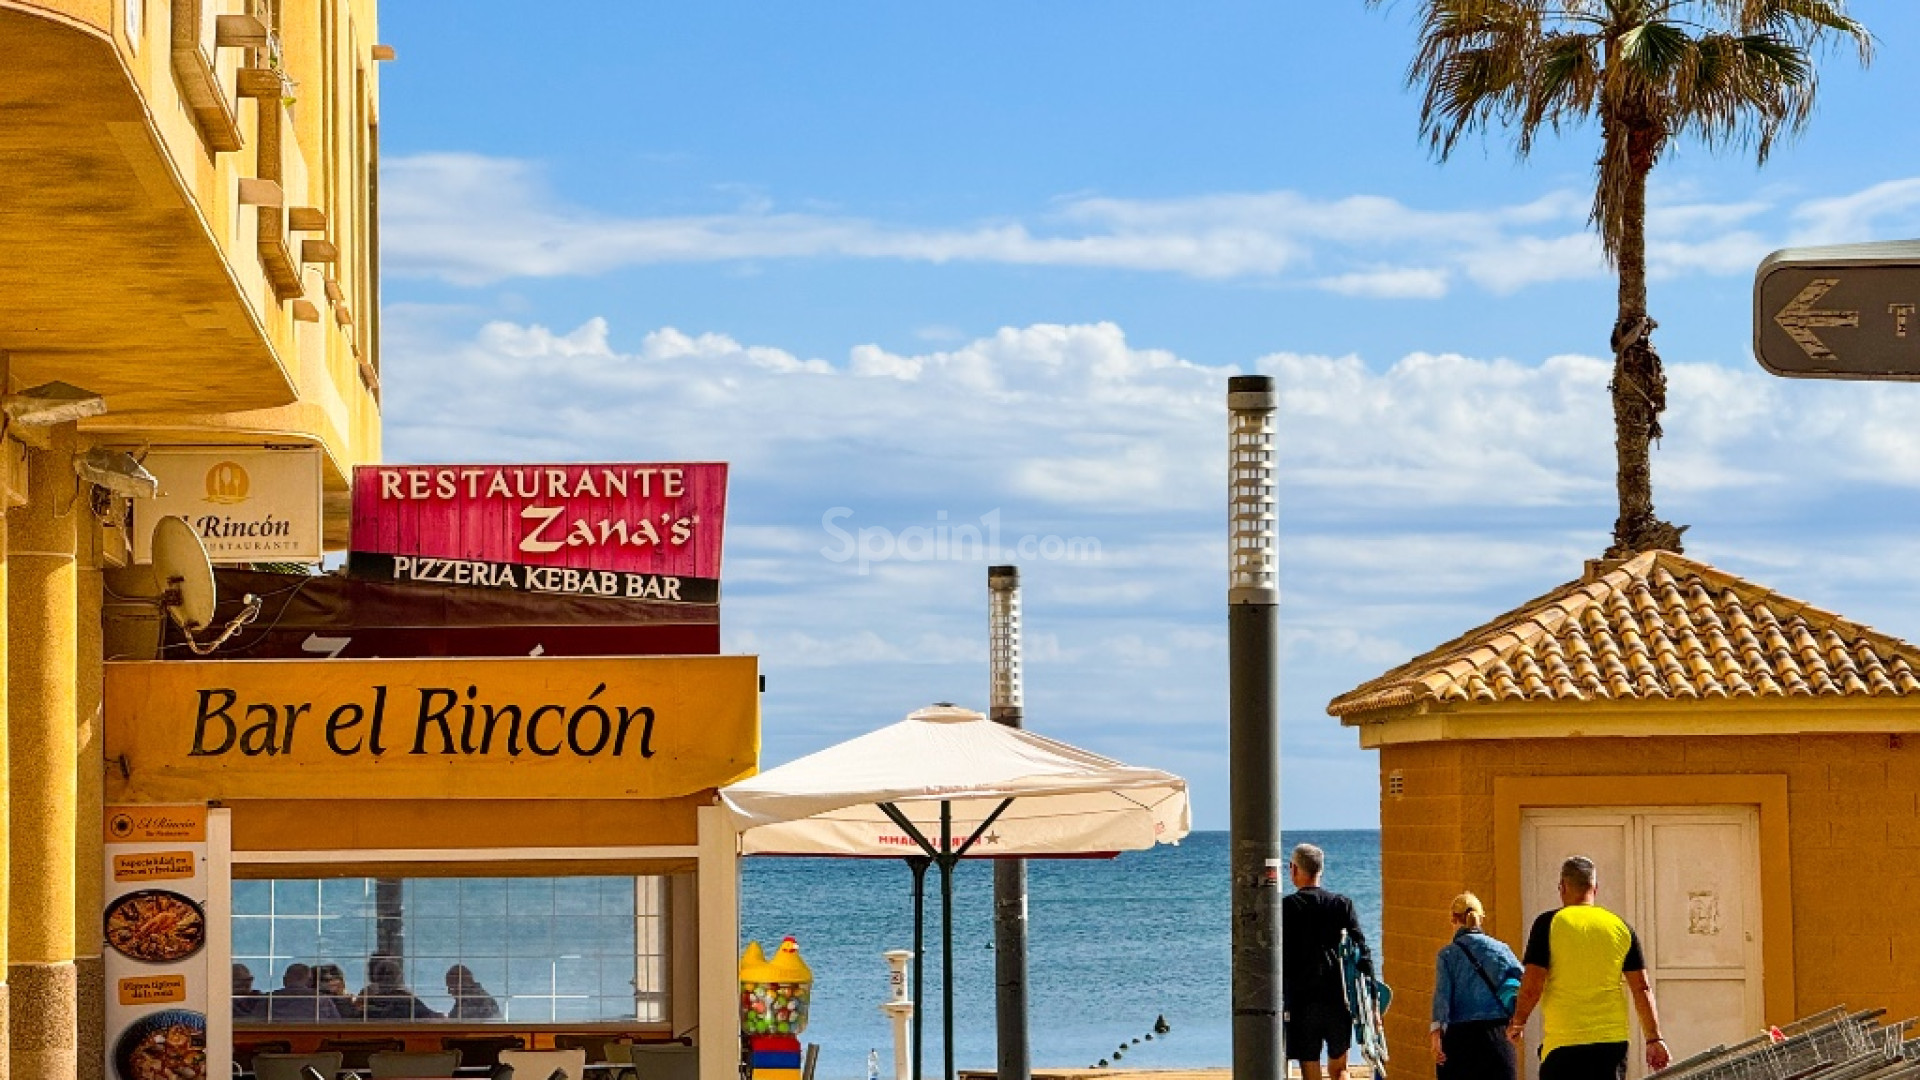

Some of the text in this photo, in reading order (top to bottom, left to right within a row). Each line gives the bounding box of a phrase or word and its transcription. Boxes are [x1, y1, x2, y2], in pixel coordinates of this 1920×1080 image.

[379, 469, 685, 499] RESTAURANTE
[197, 514, 290, 538] Rincón
[519, 504, 698, 553] Zana's
[393, 557, 681, 601] PIZZERIA KEBAB BAR
[187, 682, 656, 759] Bar el Rincón
